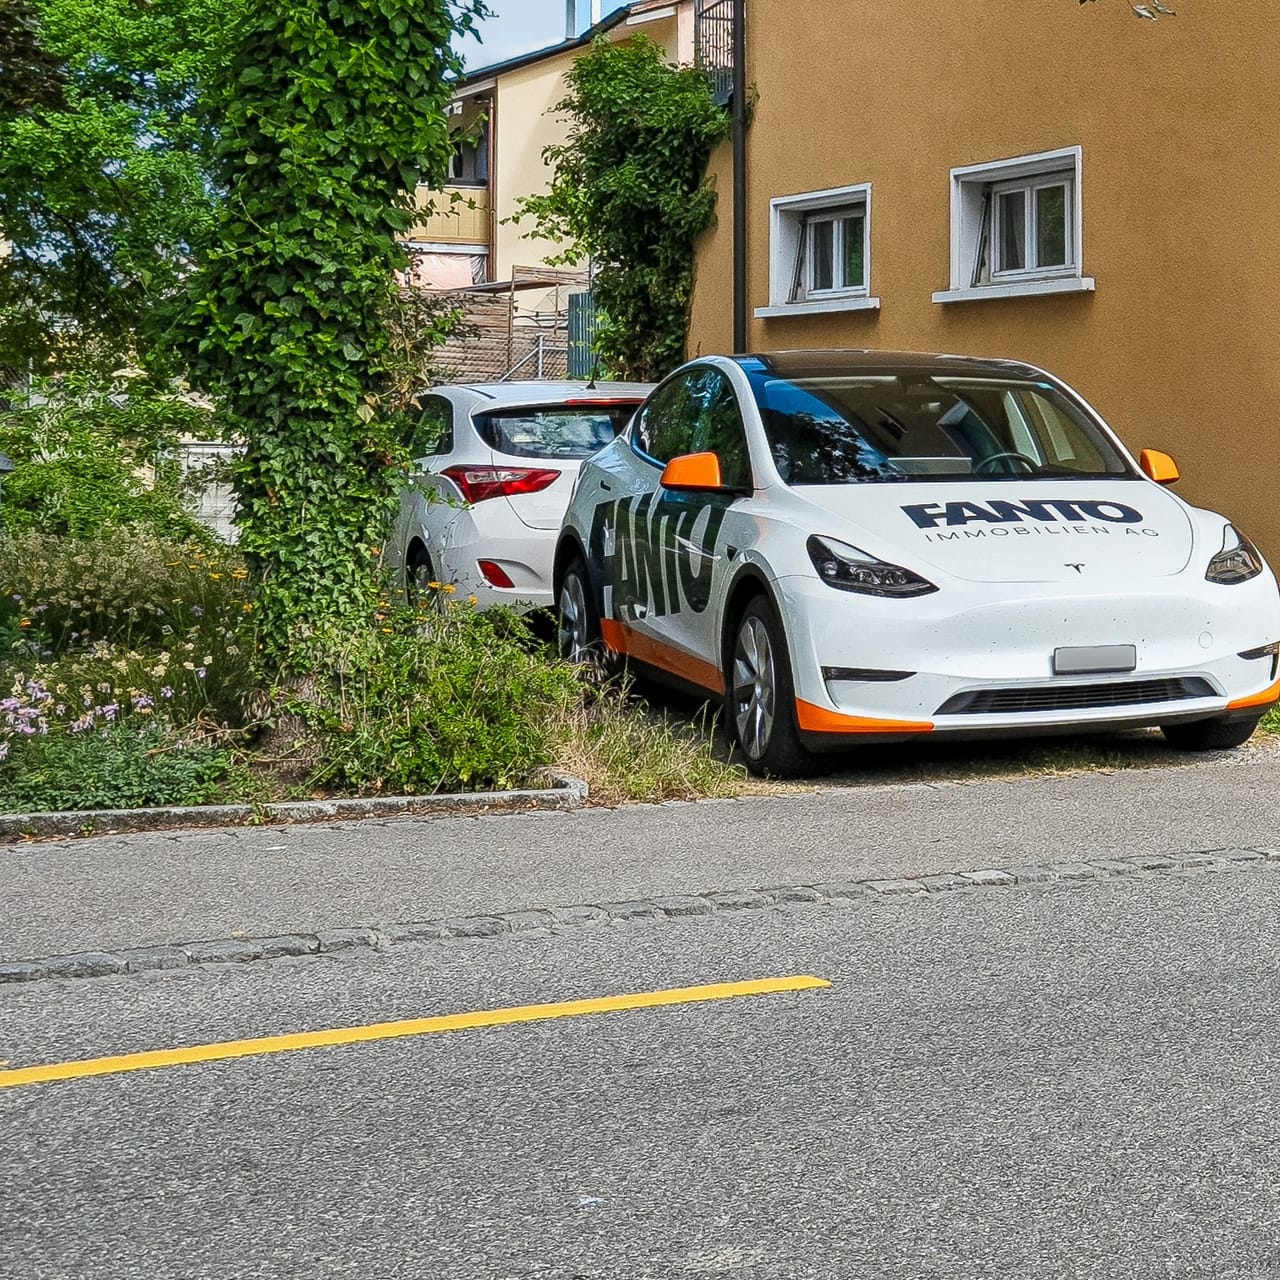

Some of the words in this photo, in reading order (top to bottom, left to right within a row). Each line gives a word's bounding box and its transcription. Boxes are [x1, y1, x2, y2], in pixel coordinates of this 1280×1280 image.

[900, 499, 1144, 529] FANTO
[925, 526, 1110, 543] IMMOBILIEN
[1124, 526, 1160, 537] AG
[588, 492, 727, 622] FANTO
